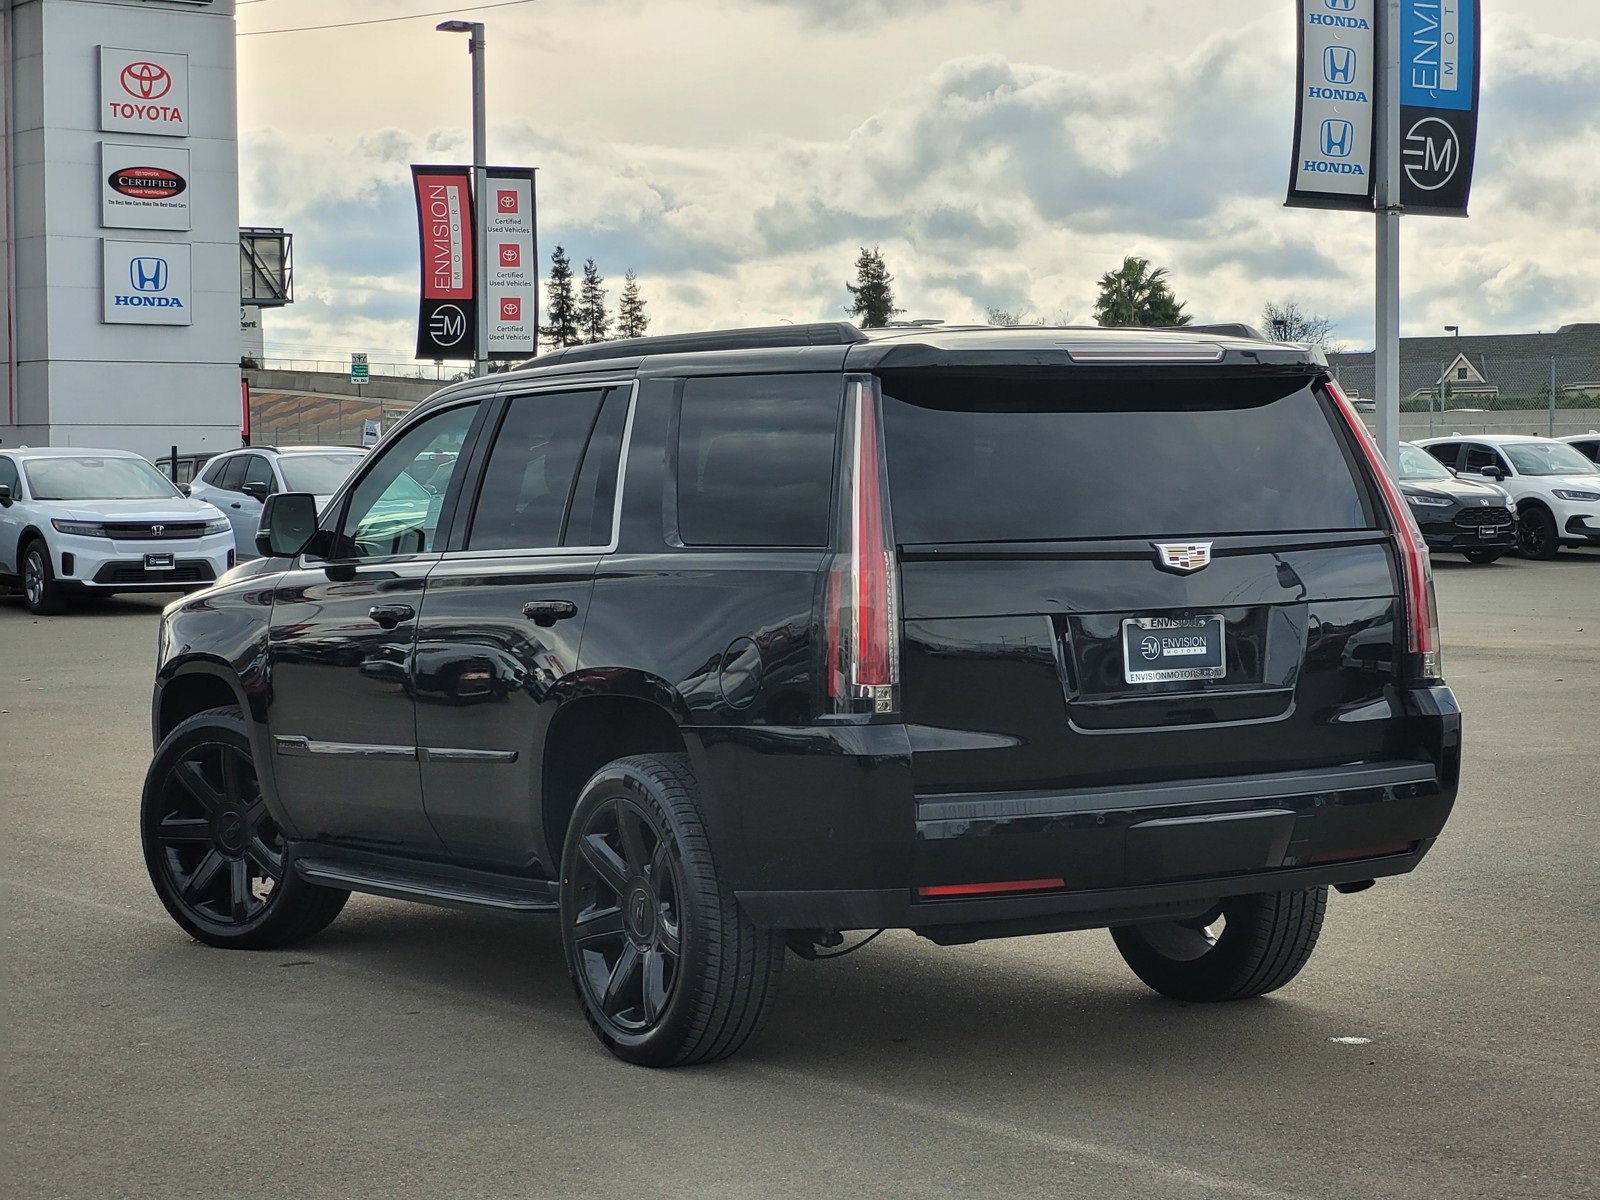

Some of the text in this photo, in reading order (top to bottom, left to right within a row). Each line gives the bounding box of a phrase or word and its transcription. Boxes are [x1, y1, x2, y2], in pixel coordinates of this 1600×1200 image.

[1309, 13, 1370, 30] HONDA
[1308, 86, 1369, 103] HONDA
[110, 102, 183, 123] TOYOTA
[1303, 160, 1365, 176] HONDA
[428, 184, 451, 290] ENVISION
[450, 194, 461, 281] MOTORS
[504, 226, 530, 234] Vehicles
[496, 271, 524, 279] Certified
[114, 295, 184, 308] HONDA
[489, 333, 531, 341] Used Vehicles
[1162, 636, 1207, 648] ENVISION
